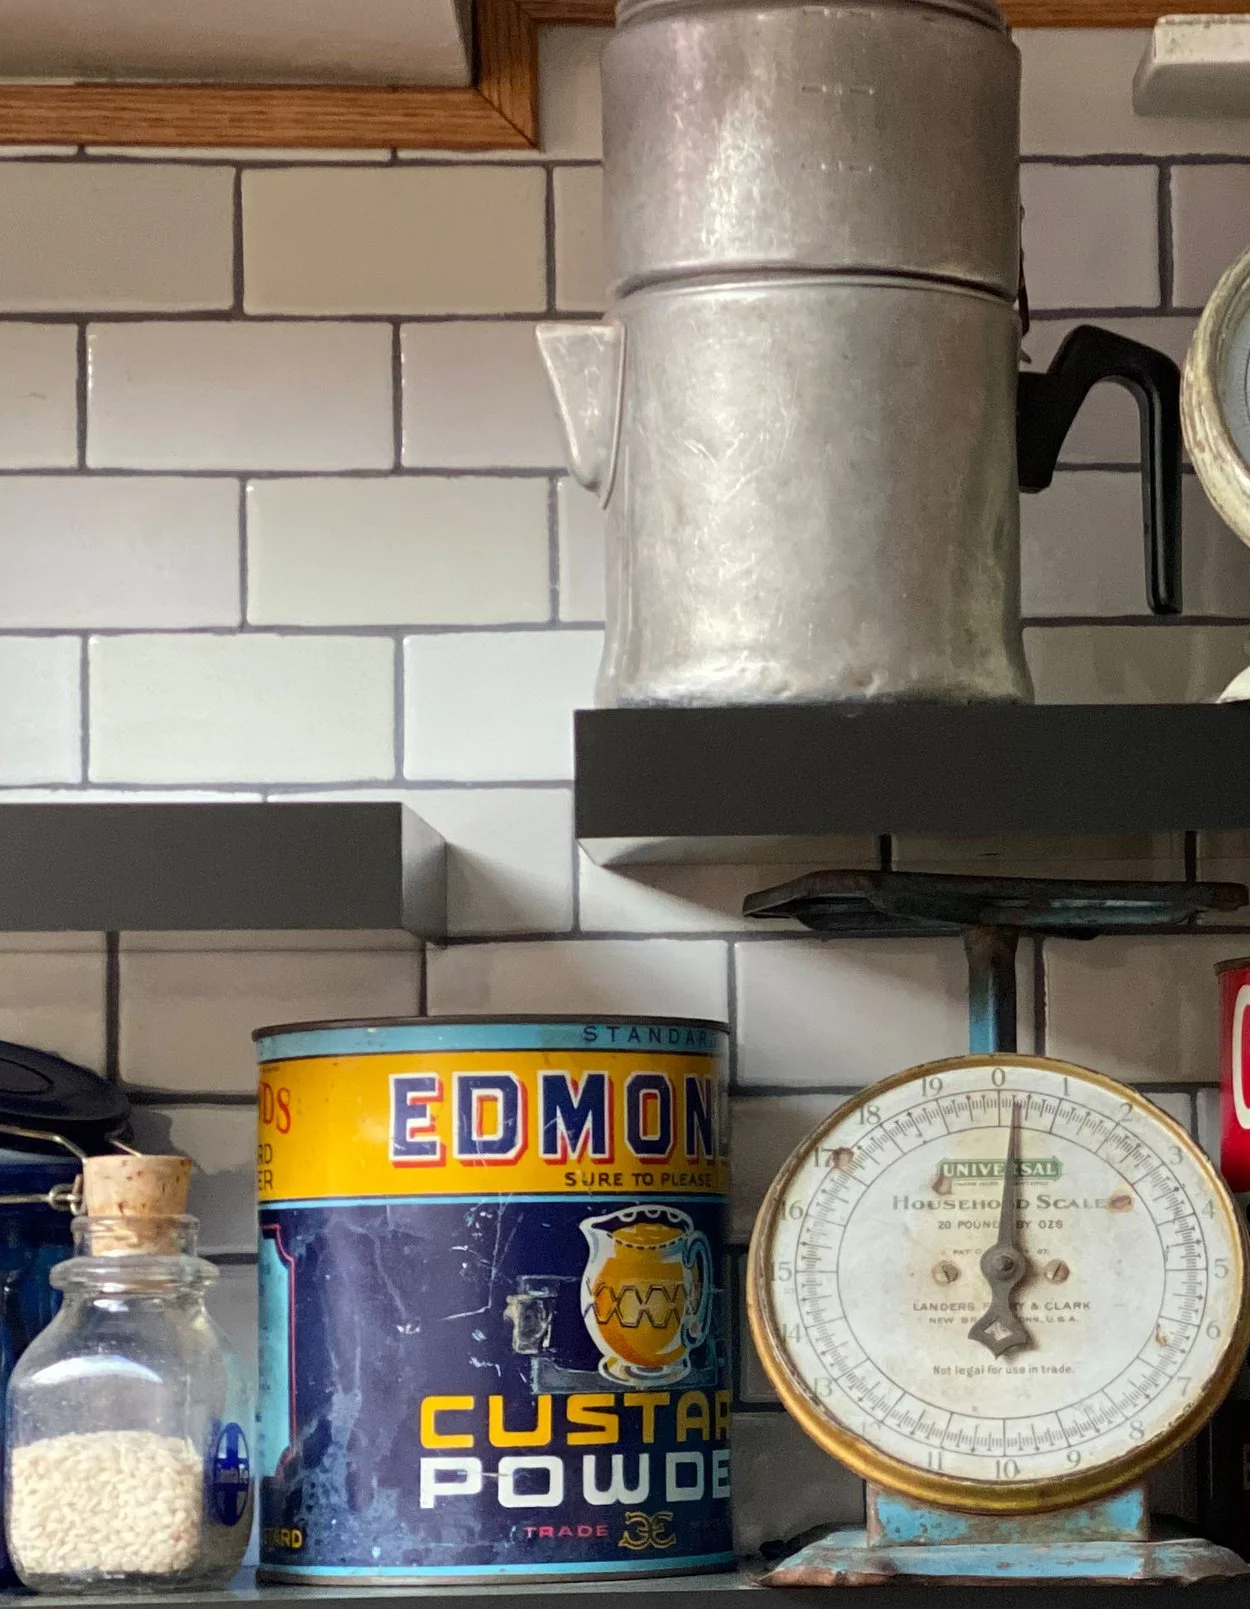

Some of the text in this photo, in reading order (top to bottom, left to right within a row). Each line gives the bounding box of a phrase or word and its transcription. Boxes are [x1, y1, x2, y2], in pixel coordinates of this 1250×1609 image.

[583, 1025, 716, 1047] STANDAR
[921, 1077, 943, 1097] 19
[991, 1068, 1005, 1087] 0
[1061, 1077, 1070, 1096] 1
[857, 1104, 882, 1126] 18
[1120, 1103, 1133, 1123] 2
[1169, 1145, 1183, 1165] 3
[943, 1162, 1057, 1177] UNIVESAL
[565, 1172, 712, 1188] SURE TO PLEASE
[779, 1200, 804, 1221] 16
[892, 1195, 1030, 1211] HOUSEHOD
[1201, 1200, 1216, 1219] 4
[938, 1220, 951, 1230] 20
[957, 1220, 1000, 1230] POUND
[1214, 1259, 1229, 1279] 5
[913, 1302, 976, 1312] LANDERS
[1030, 1302, 1039, 1311] &
[1044, 1302, 1092, 1311] CLARK
[781, 1323, 801, 1343] 14
[1206, 1320, 1221, 1340] 6
[933, 1364, 1076, 1378] Not legal for use in trade.
[813, 1376, 833, 1398] 13
[1177, 1376, 1192, 1397] 7
[1129, 1419, 1145, 1440] 8
[927, 1451, 943, 1471] 11
[994, 1459, 1019, 1480] 10
[1066, 1450, 1081, 1469] 9
[523, 1524, 608, 1539] TRADE
